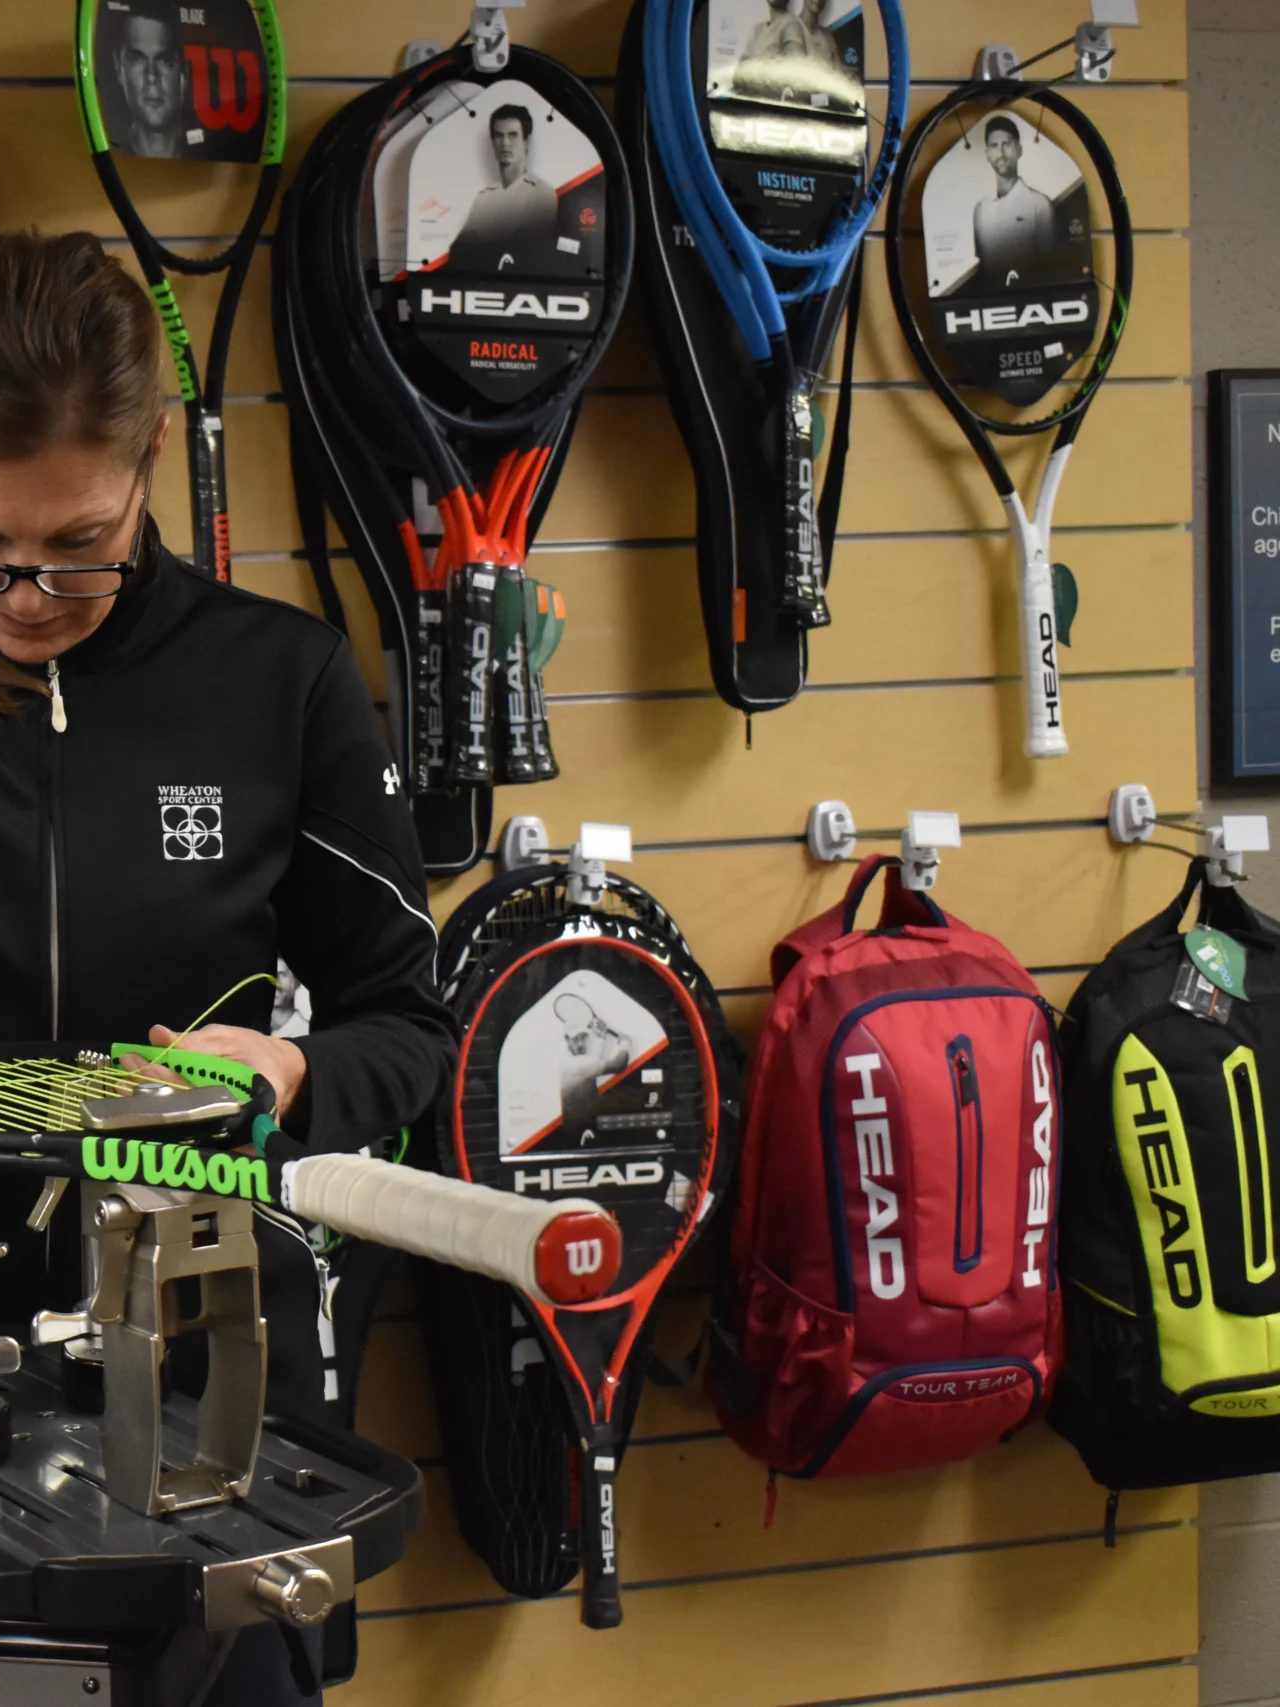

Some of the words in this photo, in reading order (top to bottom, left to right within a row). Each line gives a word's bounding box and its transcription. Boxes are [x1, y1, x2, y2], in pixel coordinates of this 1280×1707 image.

[720, 116, 855, 156] HEAD
[757, 171, 816, 193] INSTINCT
[421, 288, 590, 321] HEAD
[945, 300, 1089, 334] HEAD
[470, 341, 538, 361] RADICAL
[470, 360, 497, 370] RADICAL
[498, 360, 536, 371] VERSATILITY
[999, 350, 1042, 368] SPEED
[797, 457, 813, 584] HEAD
[1039, 612, 1060, 728] HEAD
[428, 643, 444, 768] HEAD
[468, 626, 492, 755] HEAD
[157, 785, 222, 796] WHEATON
[158, 796, 186, 804] SPORT
[188, 796, 223, 804] CENTER
[82, 1136, 272, 1203] Wilson
[514, 1161, 665, 1193] HEAD
[844, 1052, 907, 1300] HEAD
[1022, 1038, 1054, 1289] HEAD
[1124, 1067, 1202, 1310] HEAD
[900, 1381, 957, 1396] TOUR
[966, 1371, 1018, 1391] TEAM
[1210, 1398, 1268, 1410] TOUR
[600, 1483, 616, 1575] HEAD
